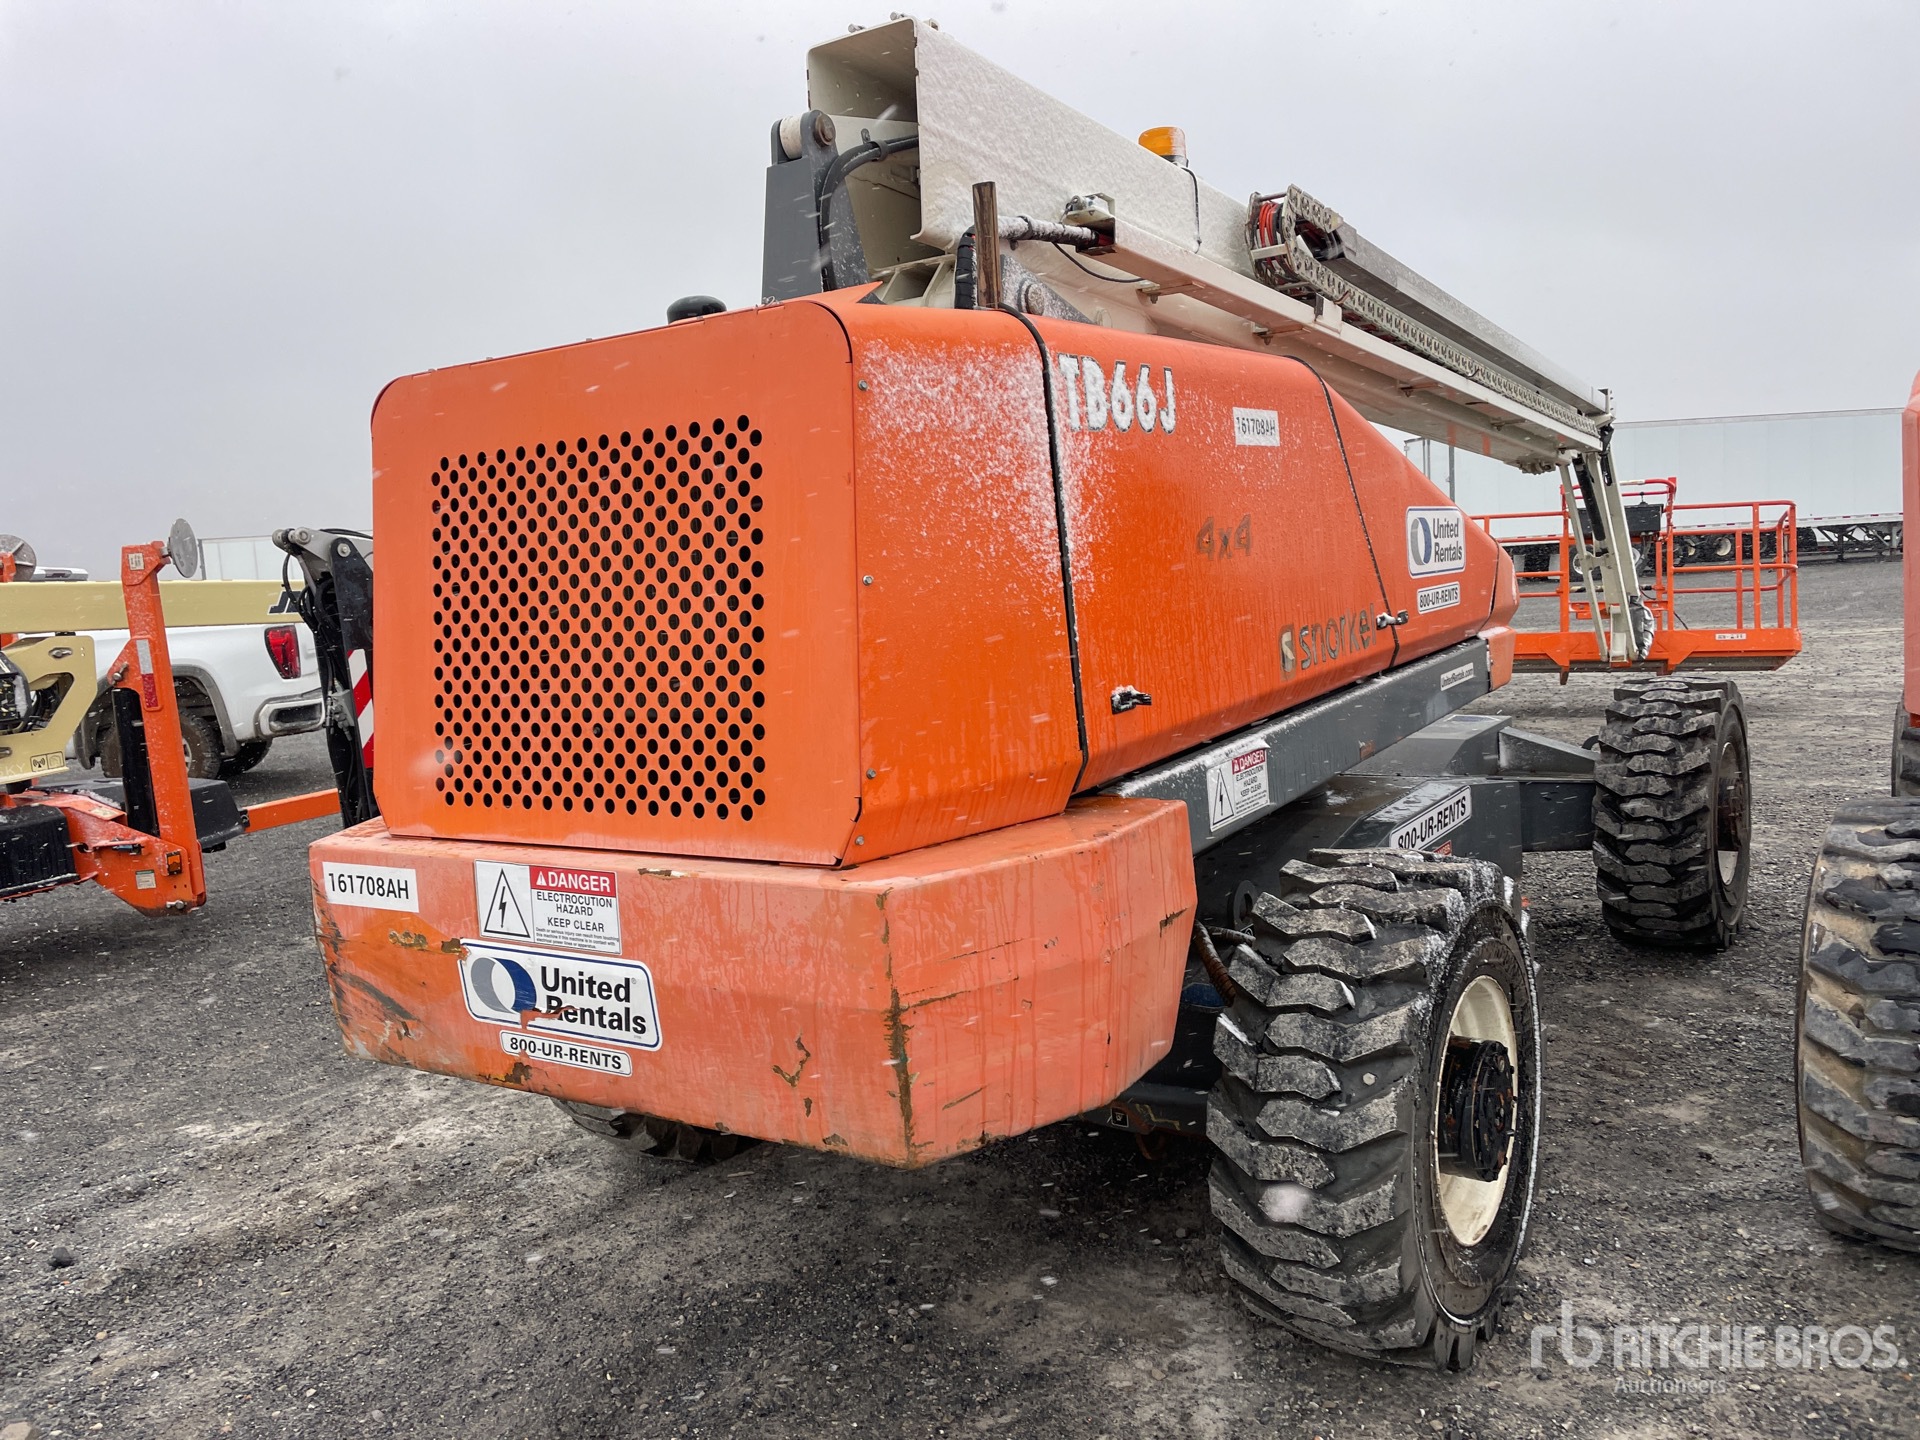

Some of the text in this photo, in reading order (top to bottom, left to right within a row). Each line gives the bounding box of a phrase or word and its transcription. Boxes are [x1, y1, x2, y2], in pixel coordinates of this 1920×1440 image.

[1057, 352, 1177, 433] TB66J
[1235, 416, 1276, 436] 161708AH
[1196, 513, 1252, 561] 4x4
[1432, 517, 1459, 540] United
[1433, 540, 1463, 563] Rentals
[1419, 586, 1459, 609] 800-UR-RENTS
[1299, 602, 1377, 671] snorkel
[1239, 748, 1265, 772] DANGER
[1240, 782, 1262, 798] KEEP CLEAR
[1397, 795, 1467, 850] 800-UR-RENTS
[328, 872, 410, 900] 161708AH
[547, 871, 611, 893] DANGER
[536, 891, 613, 908] ELECTROCUTION
[556, 903, 594, 917] HAZARD
[547, 916, 605, 933] KEEP CLEAR
[541, 966, 631, 1003] United
[546, 995, 647, 1034] Rentals
[509, 1037, 622, 1070] 800-UR-RENTS
